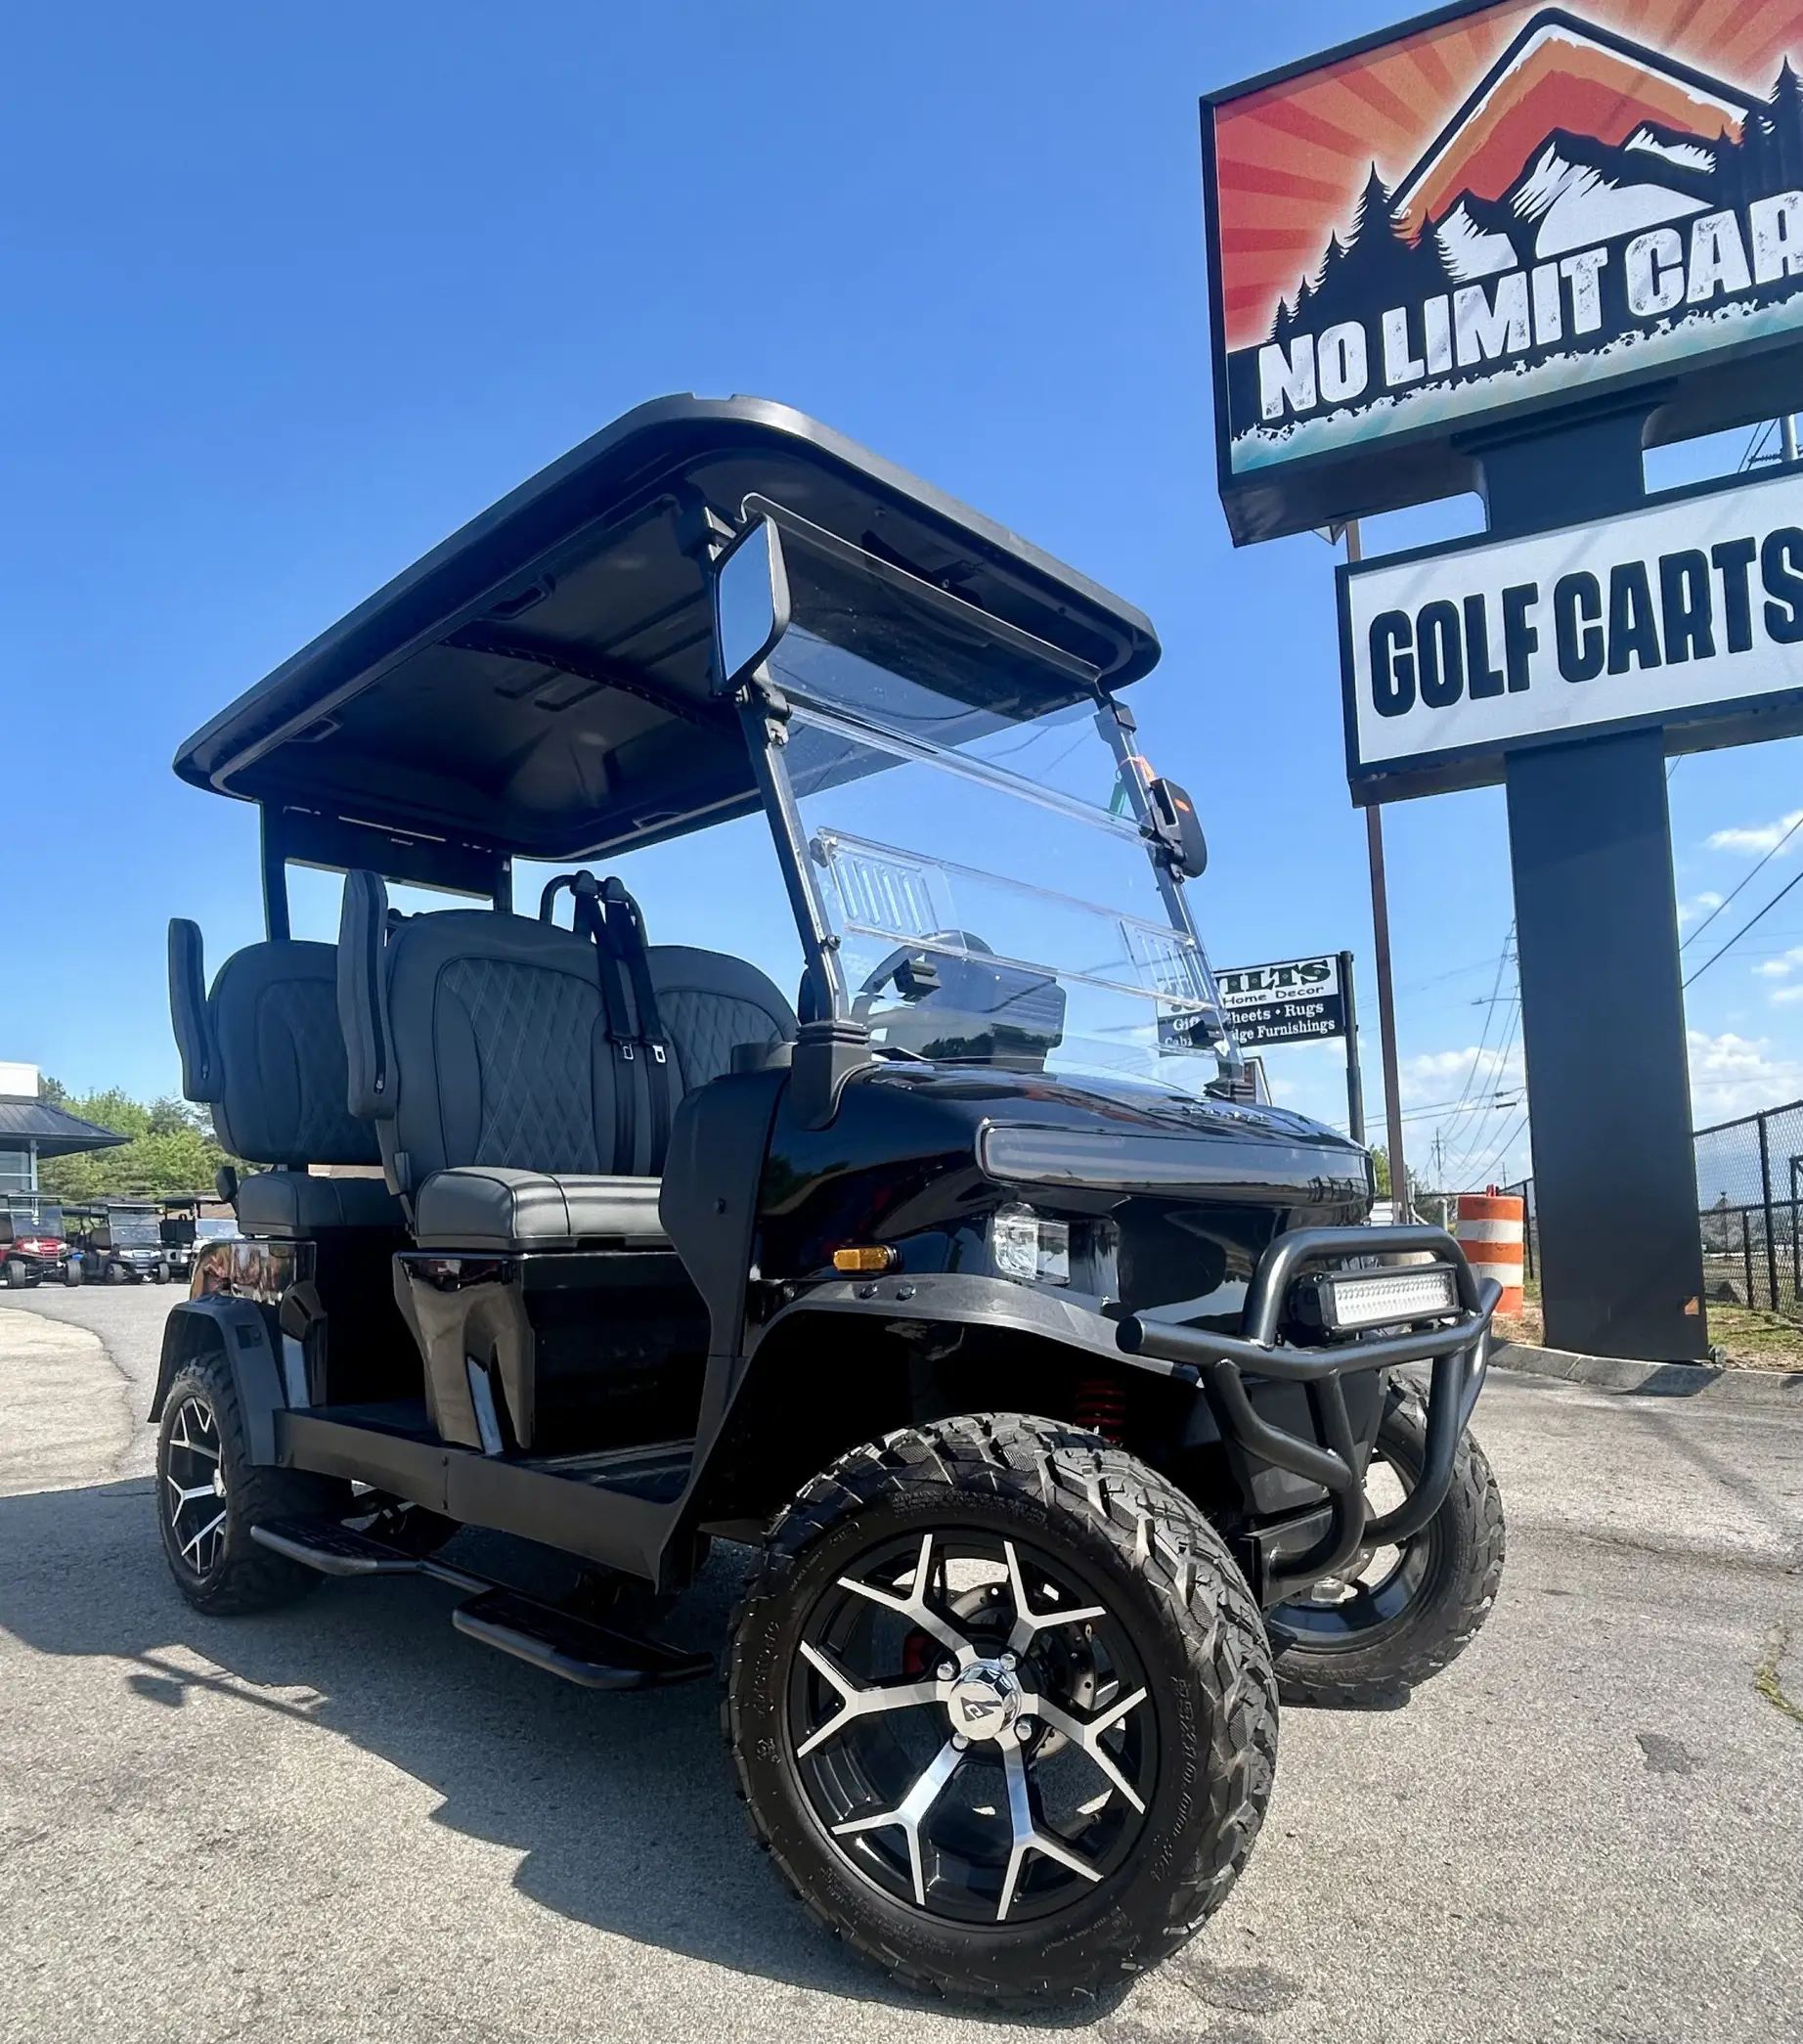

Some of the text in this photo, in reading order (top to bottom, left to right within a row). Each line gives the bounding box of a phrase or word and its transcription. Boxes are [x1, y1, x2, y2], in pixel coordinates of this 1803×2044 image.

[1258, 320, 1369, 422] NO
[1382, 245, 1610, 388] LIMIT
[1369, 525, 1803, 719] GOLF CARTS
[1223, 985, 1325, 1005] Home Decor
[1226, 1007, 1271, 1024] heets
[1284, 1002, 1325, 1018] Rugs
[1256, 1019, 1336, 1040] Furnishings
